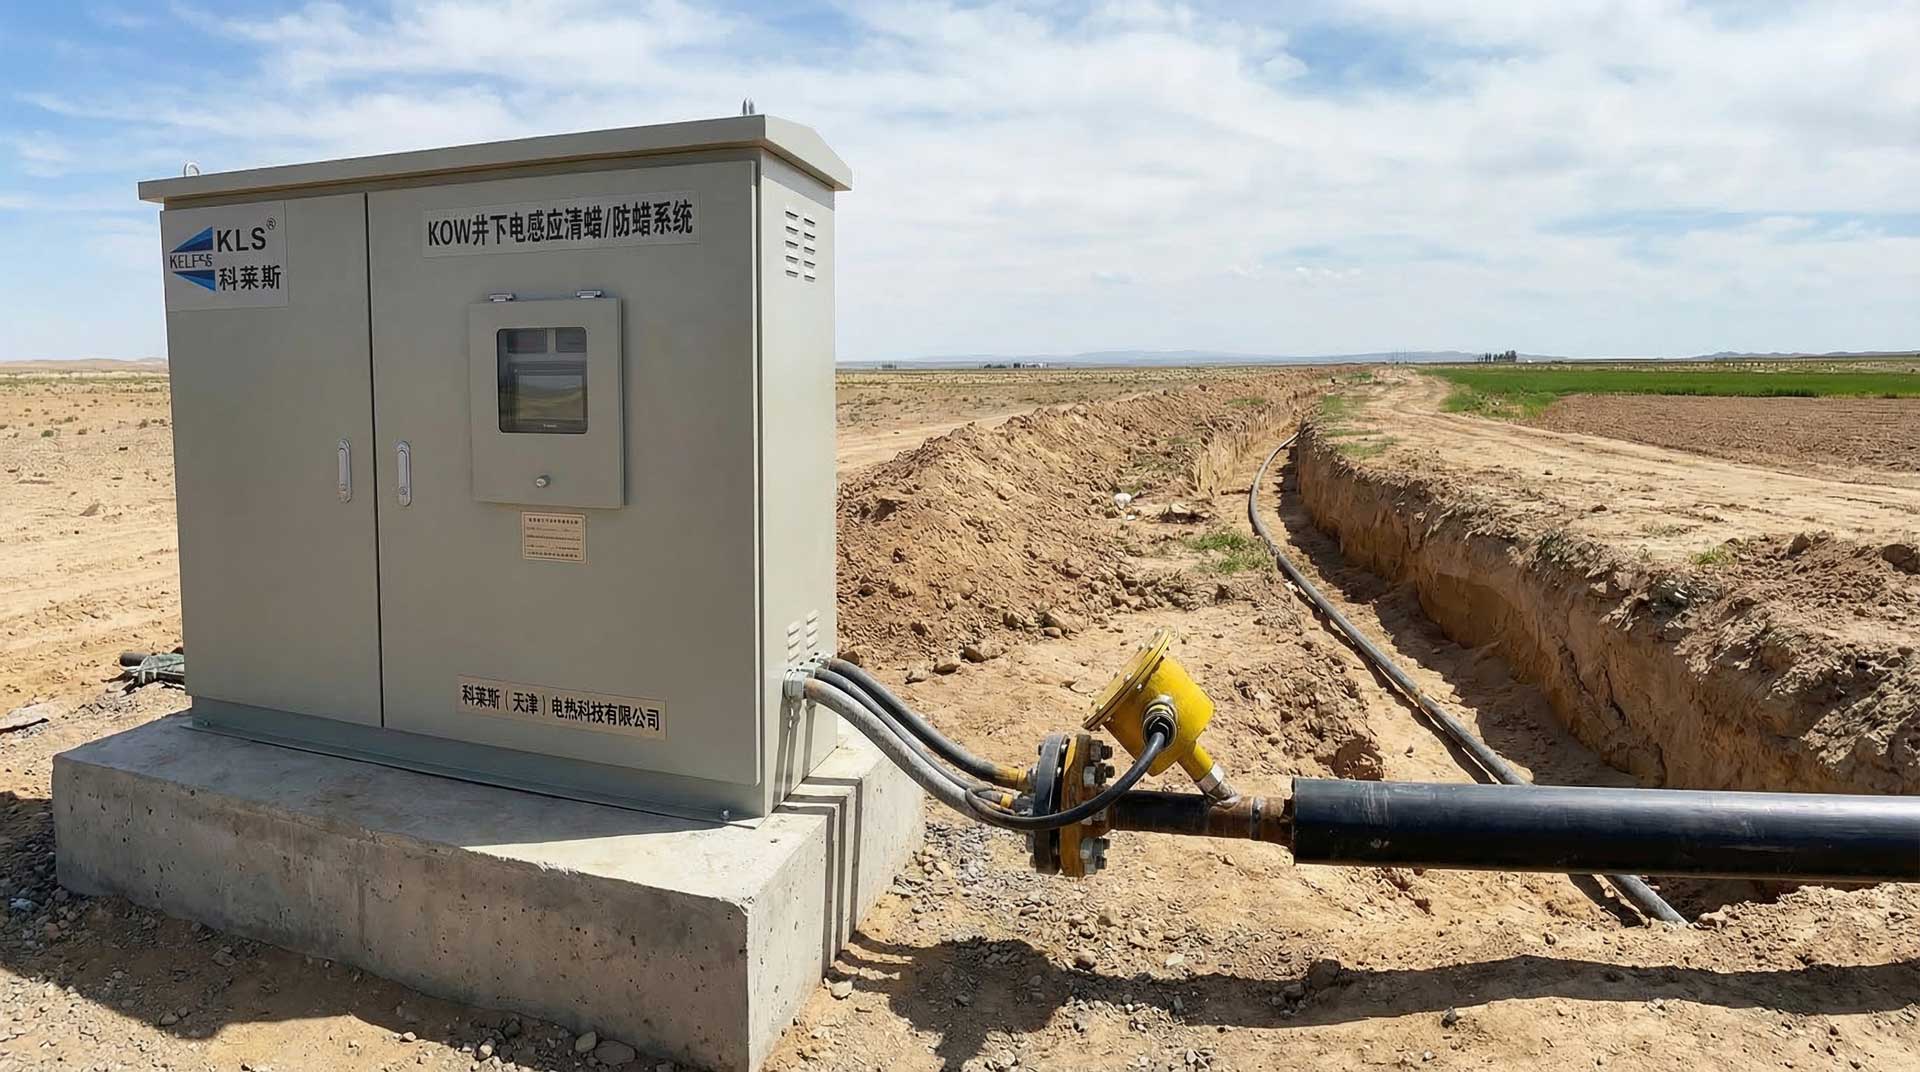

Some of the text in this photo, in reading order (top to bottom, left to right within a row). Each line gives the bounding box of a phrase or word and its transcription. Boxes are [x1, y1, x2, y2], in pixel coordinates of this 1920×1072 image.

[428, 199, 693, 246] KOW井下电感应清蜡/防蜡系统
[218, 264, 282, 291] 科莱斯
